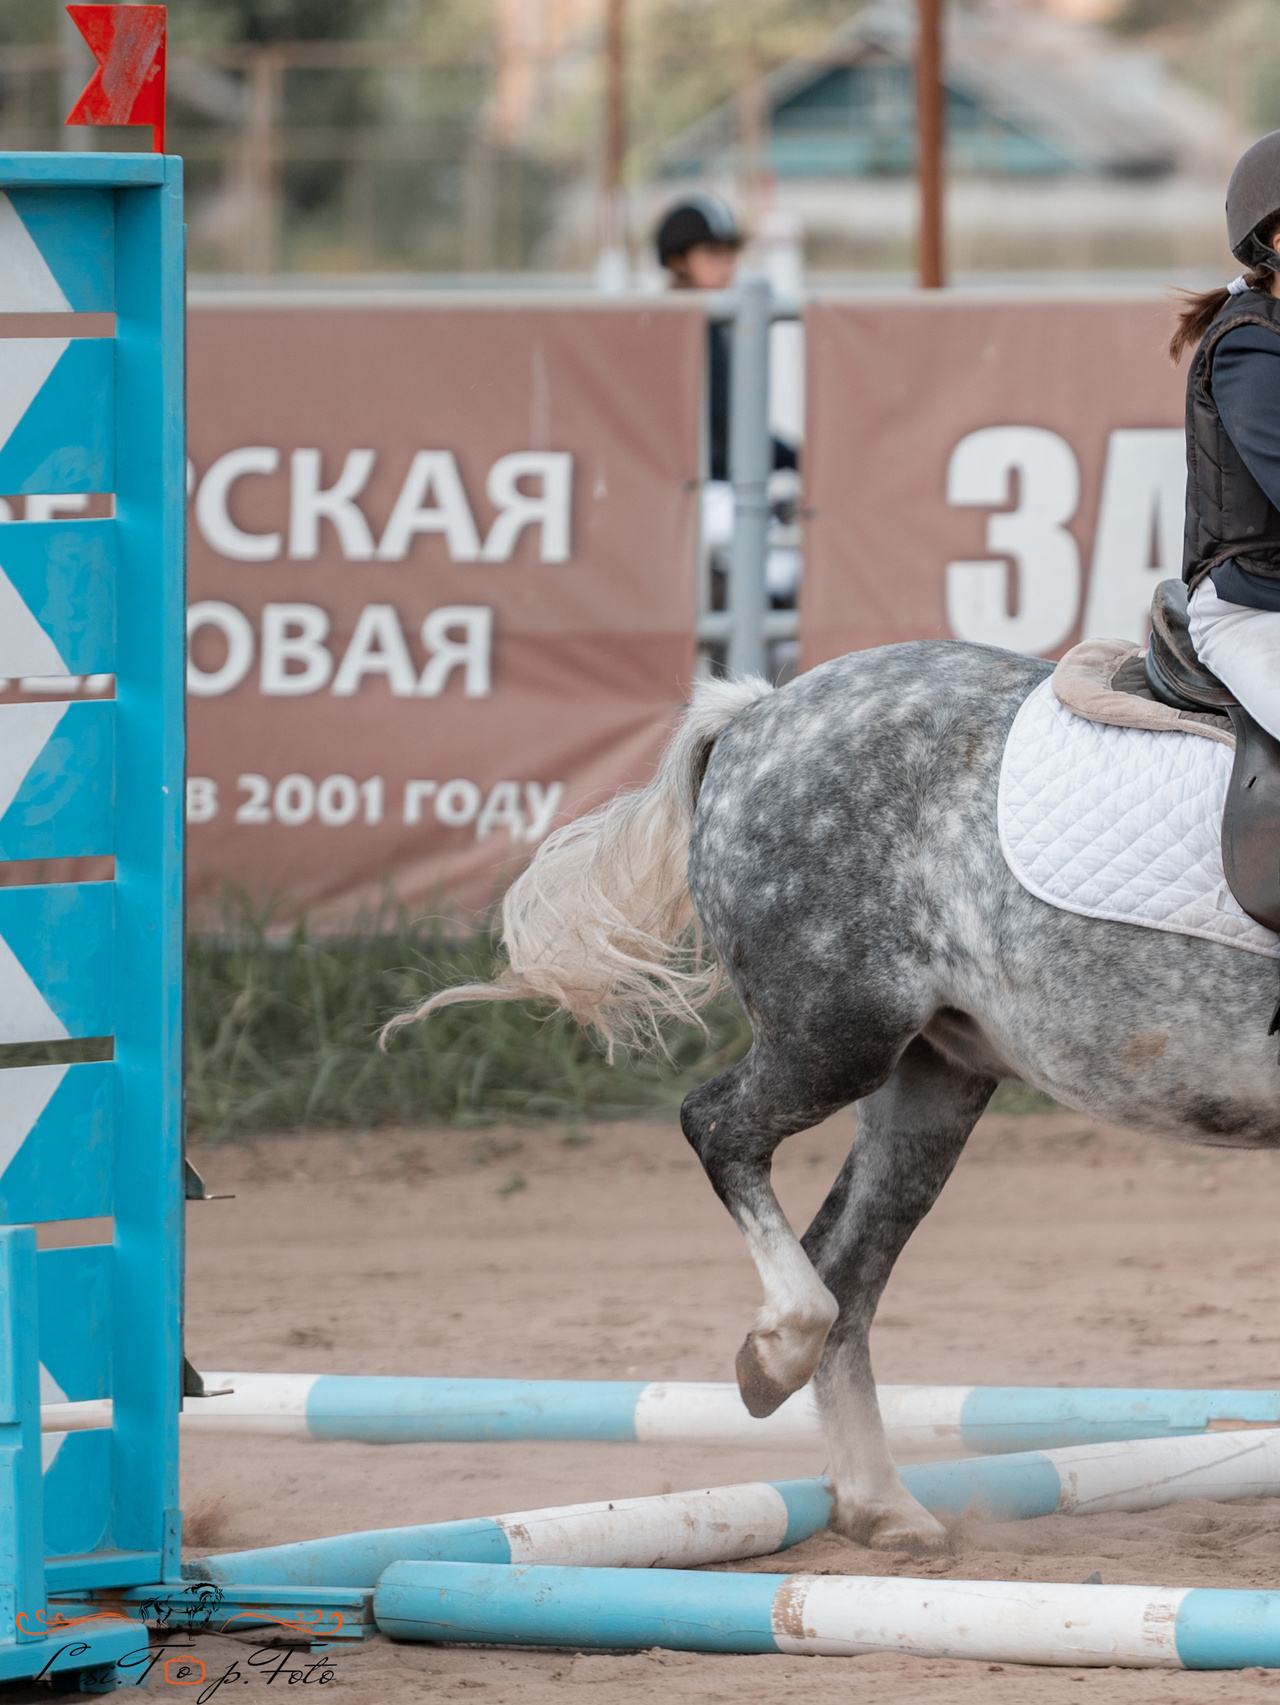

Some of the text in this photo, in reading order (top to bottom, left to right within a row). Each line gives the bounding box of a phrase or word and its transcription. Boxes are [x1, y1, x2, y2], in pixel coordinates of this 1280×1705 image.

[186, 446, 572, 562] СКАЯ
[236, 773, 385, 826] 2001
[404, 777, 566, 843] году
